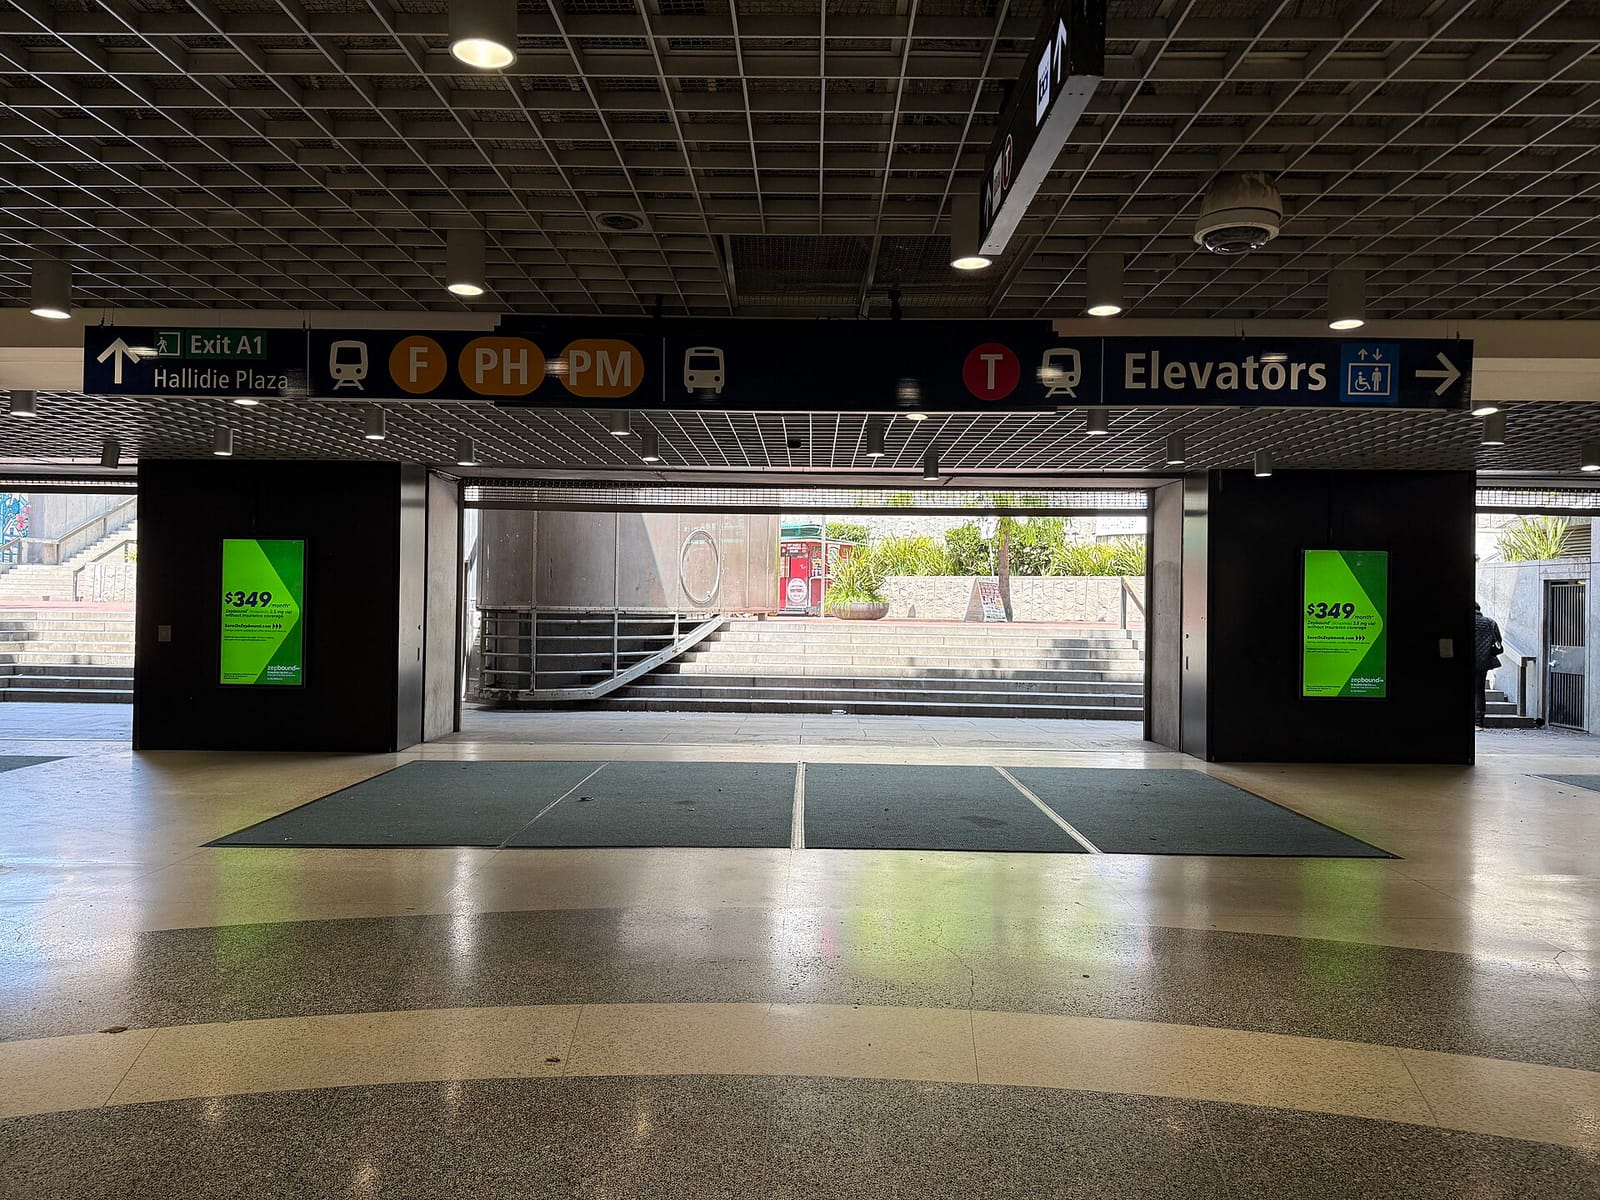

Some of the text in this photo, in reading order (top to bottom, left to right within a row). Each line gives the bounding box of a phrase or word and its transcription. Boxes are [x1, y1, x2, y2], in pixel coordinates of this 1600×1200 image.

[190, 335, 262, 355] Exit A1
[153, 367, 289, 391] Hallidie Plaza
[409, 346, 429, 383] F
[475, 347, 528, 385] PH
[569, 350, 632, 387] PM
[980, 353, 1003, 390] T
[1124, 350, 1327, 391] Elevators
[224, 591, 272, 608] $349
[1307, 602, 1355, 619] $349
